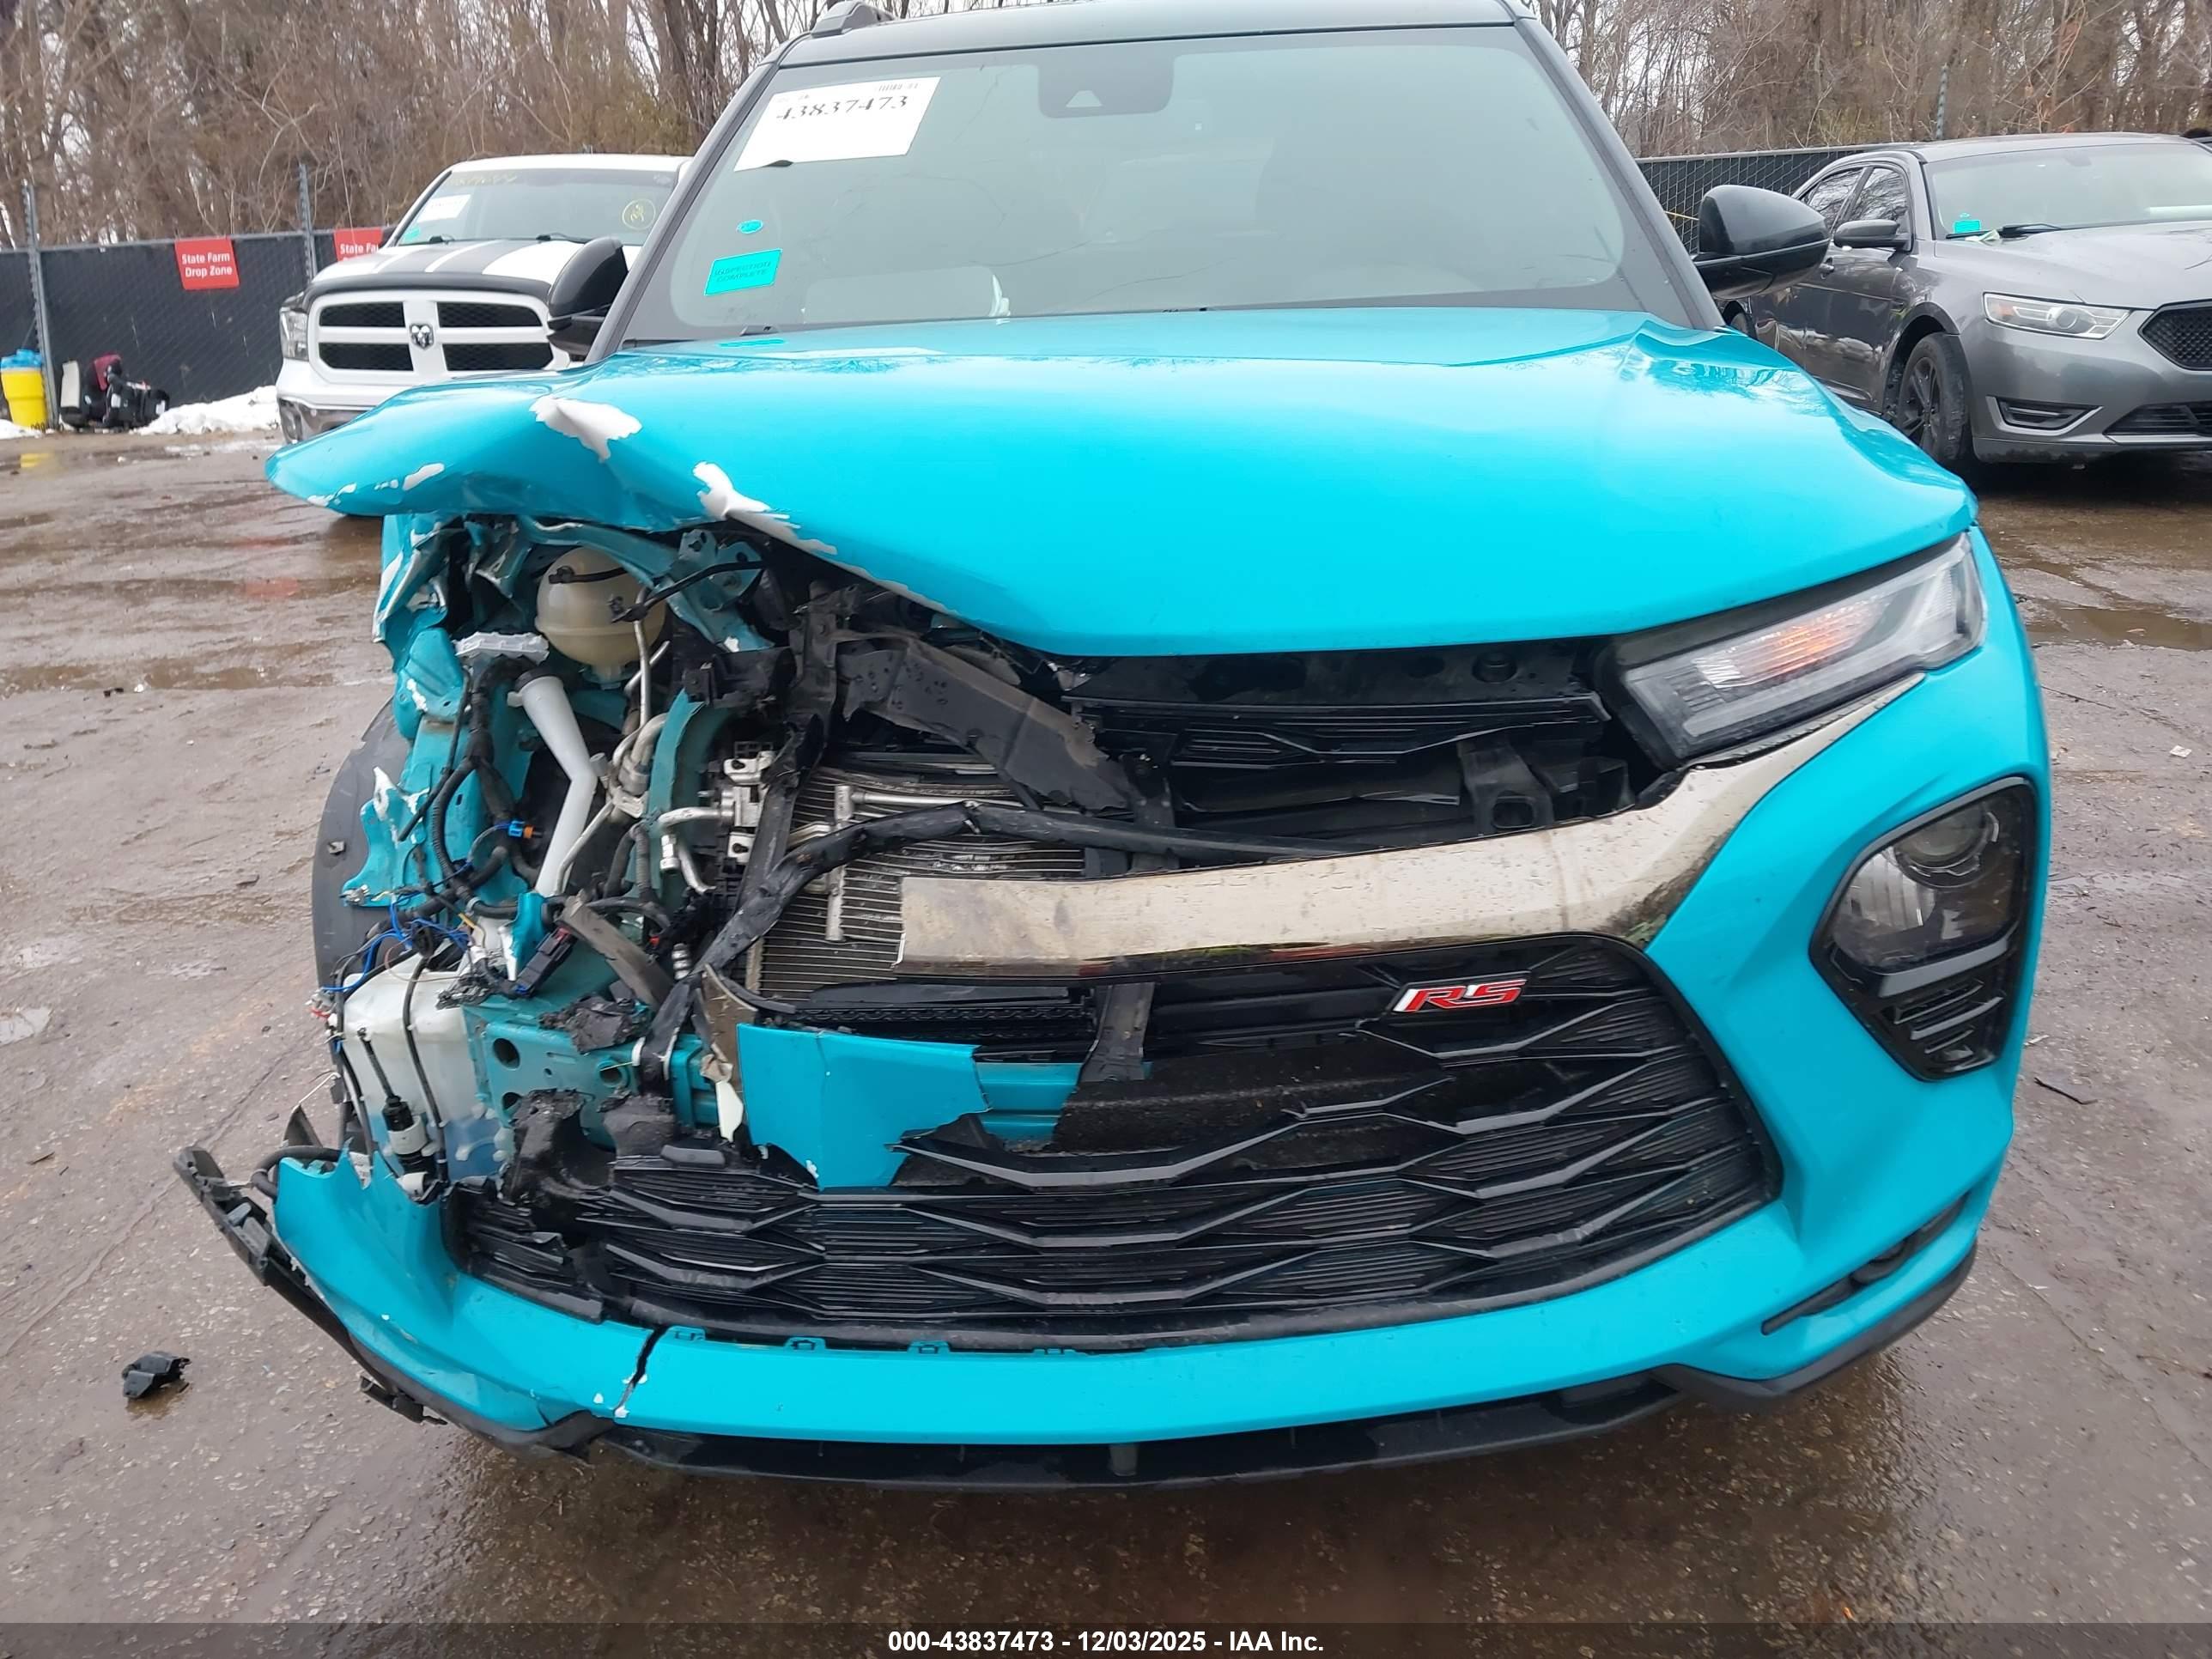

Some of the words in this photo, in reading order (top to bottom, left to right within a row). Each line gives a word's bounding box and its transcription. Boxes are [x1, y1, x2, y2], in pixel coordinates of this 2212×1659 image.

[775, 94, 908, 121] 43837473
[340, 243, 364, 254] State
[366, 243, 380, 253] Fa
[181, 252, 206, 264] State
[207, 252, 230, 264] Farm
[185, 267, 208, 279] Drop
[210, 265, 233, 276] Zone
[1393, 978, 1528, 1013] RS
